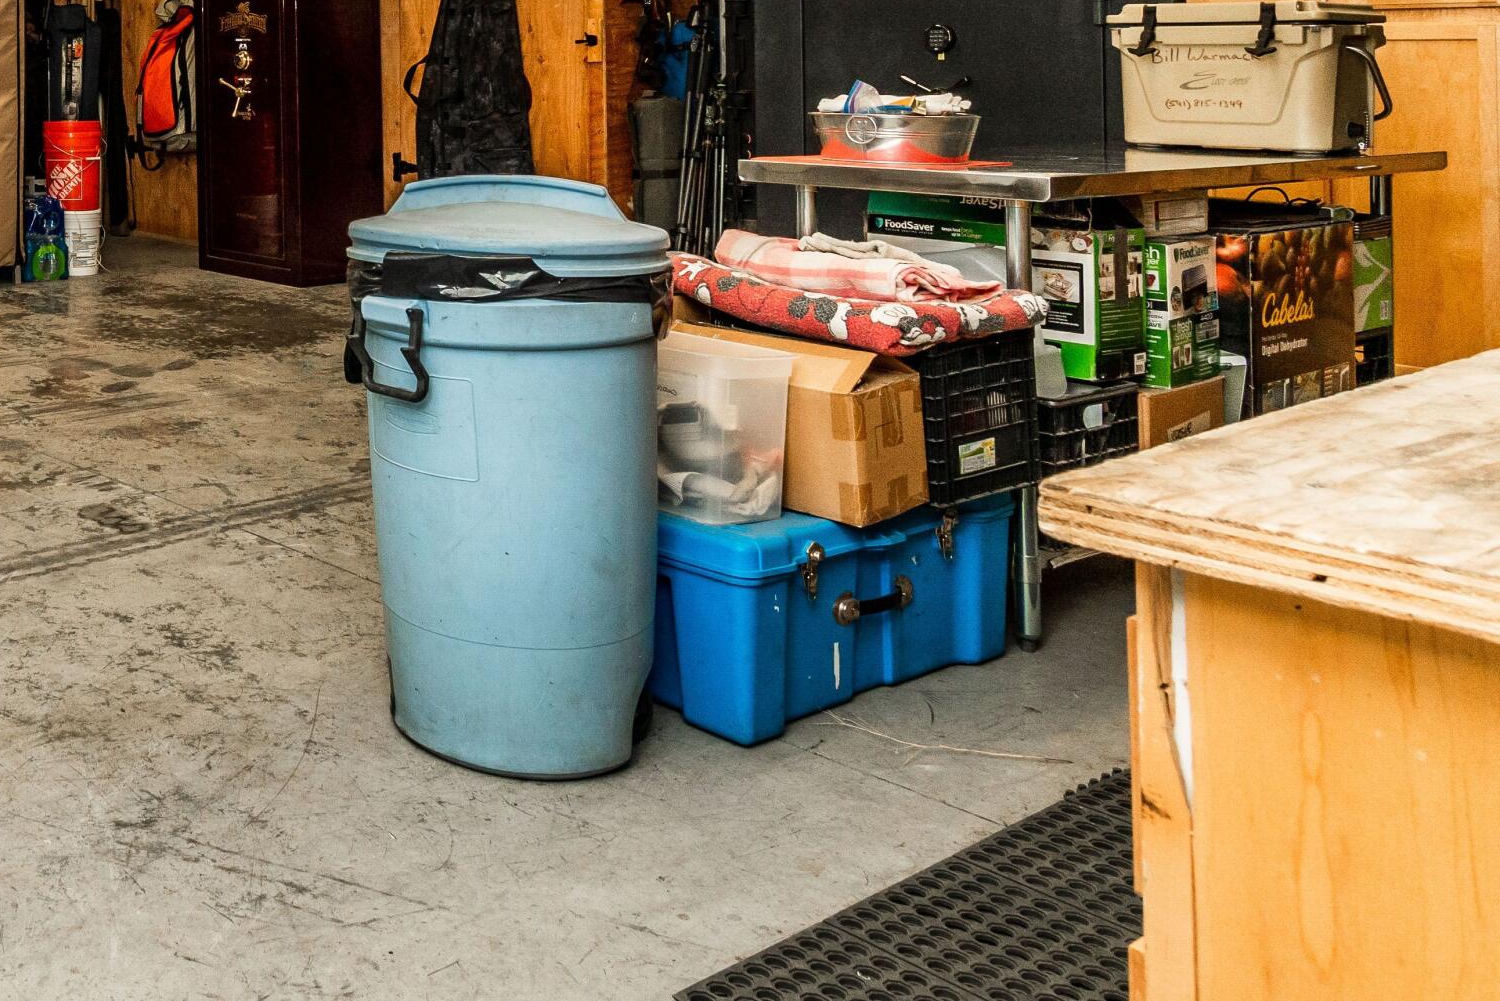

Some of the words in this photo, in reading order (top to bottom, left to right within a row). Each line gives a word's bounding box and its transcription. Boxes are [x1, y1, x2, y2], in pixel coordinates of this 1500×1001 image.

[1151, 47, 1179, 64] Bill
[49, 161, 81, 198] HOME
[59, 175, 82, 200] DEPOT
[884, 219, 935, 232] FoodSaver
[1179, 246, 1209, 259] FoodSaver
[1262, 291, 1314, 328] Cabela's
[1262, 343, 1281, 357] Digital
[1280, 338, 1308, 354] Dehydrator
